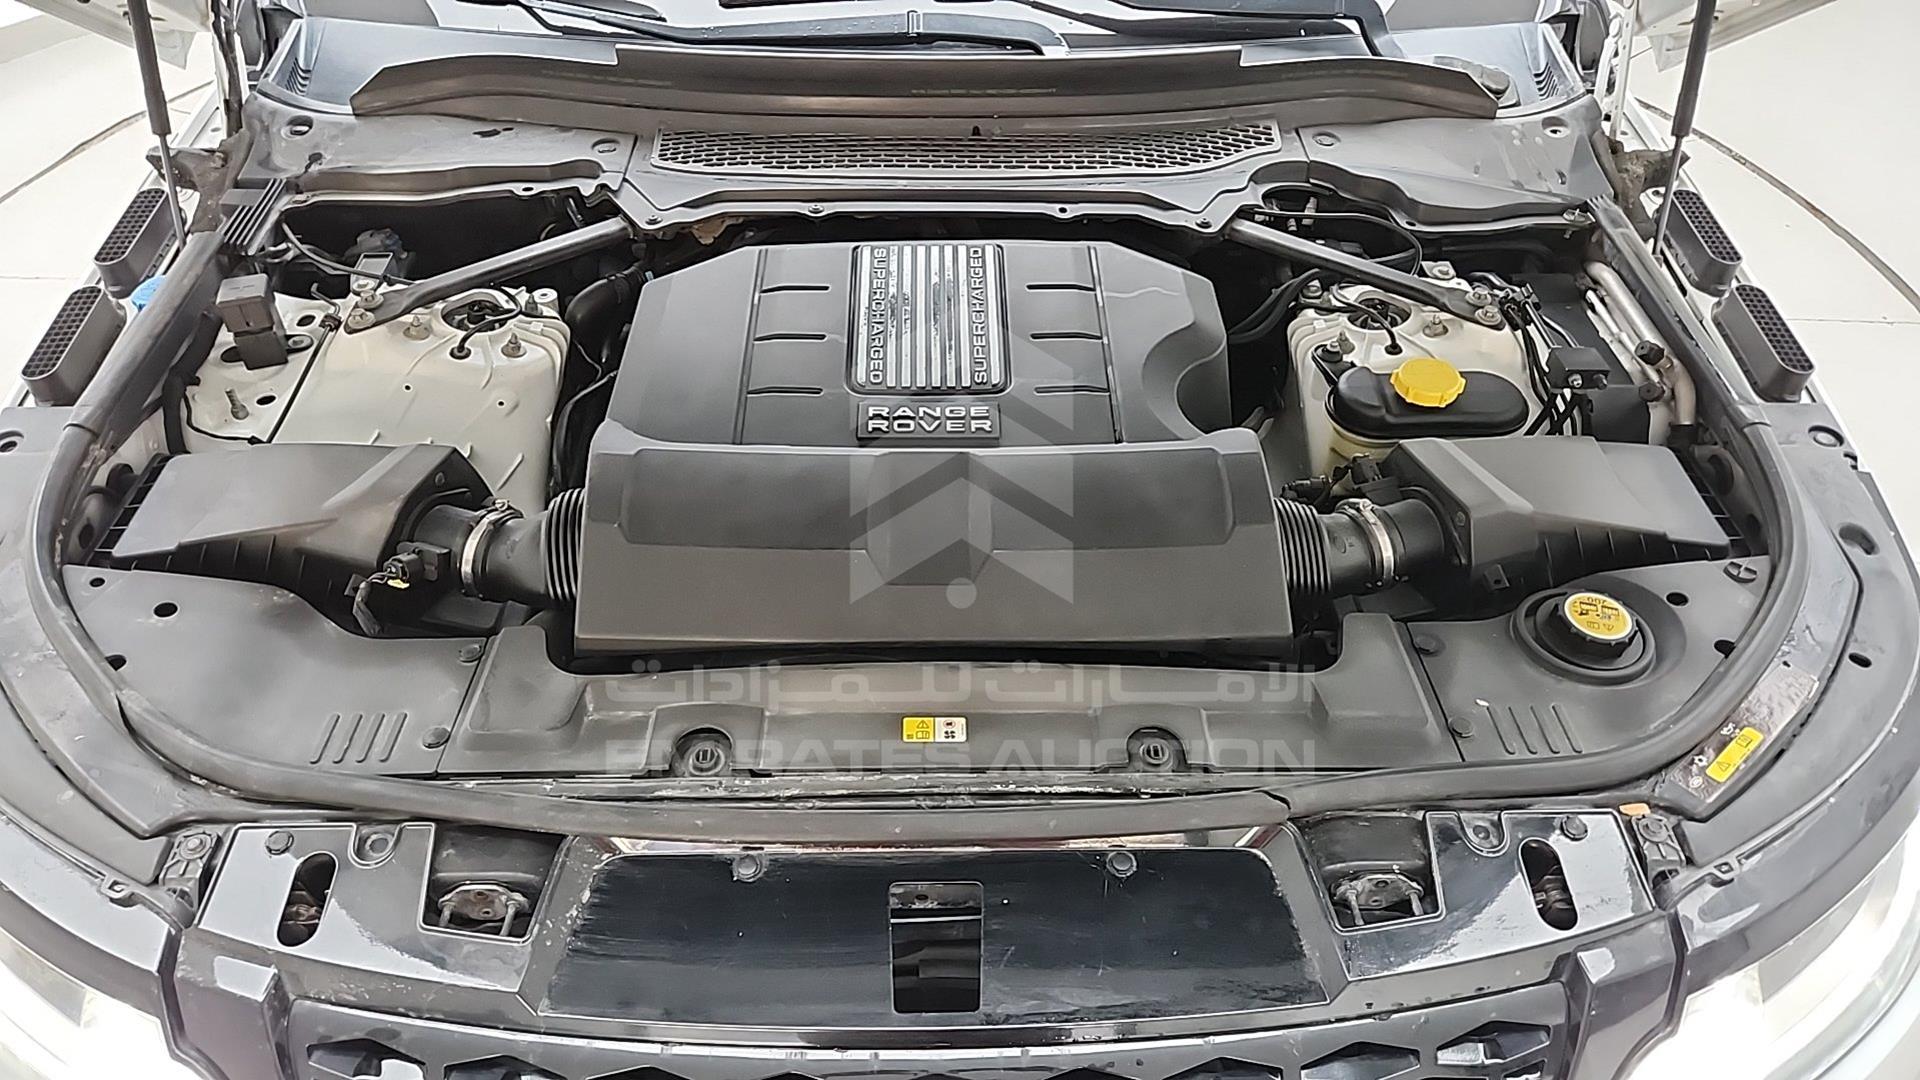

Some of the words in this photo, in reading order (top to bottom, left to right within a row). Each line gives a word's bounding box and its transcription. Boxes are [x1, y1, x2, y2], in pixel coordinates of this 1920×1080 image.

[869, 247, 888, 384] SUPERCHARGED
[969, 247, 988, 384] SUPERCHARGED
[867, 405, 990, 417] RANGE
[867, 420, 993, 432] ROVER
